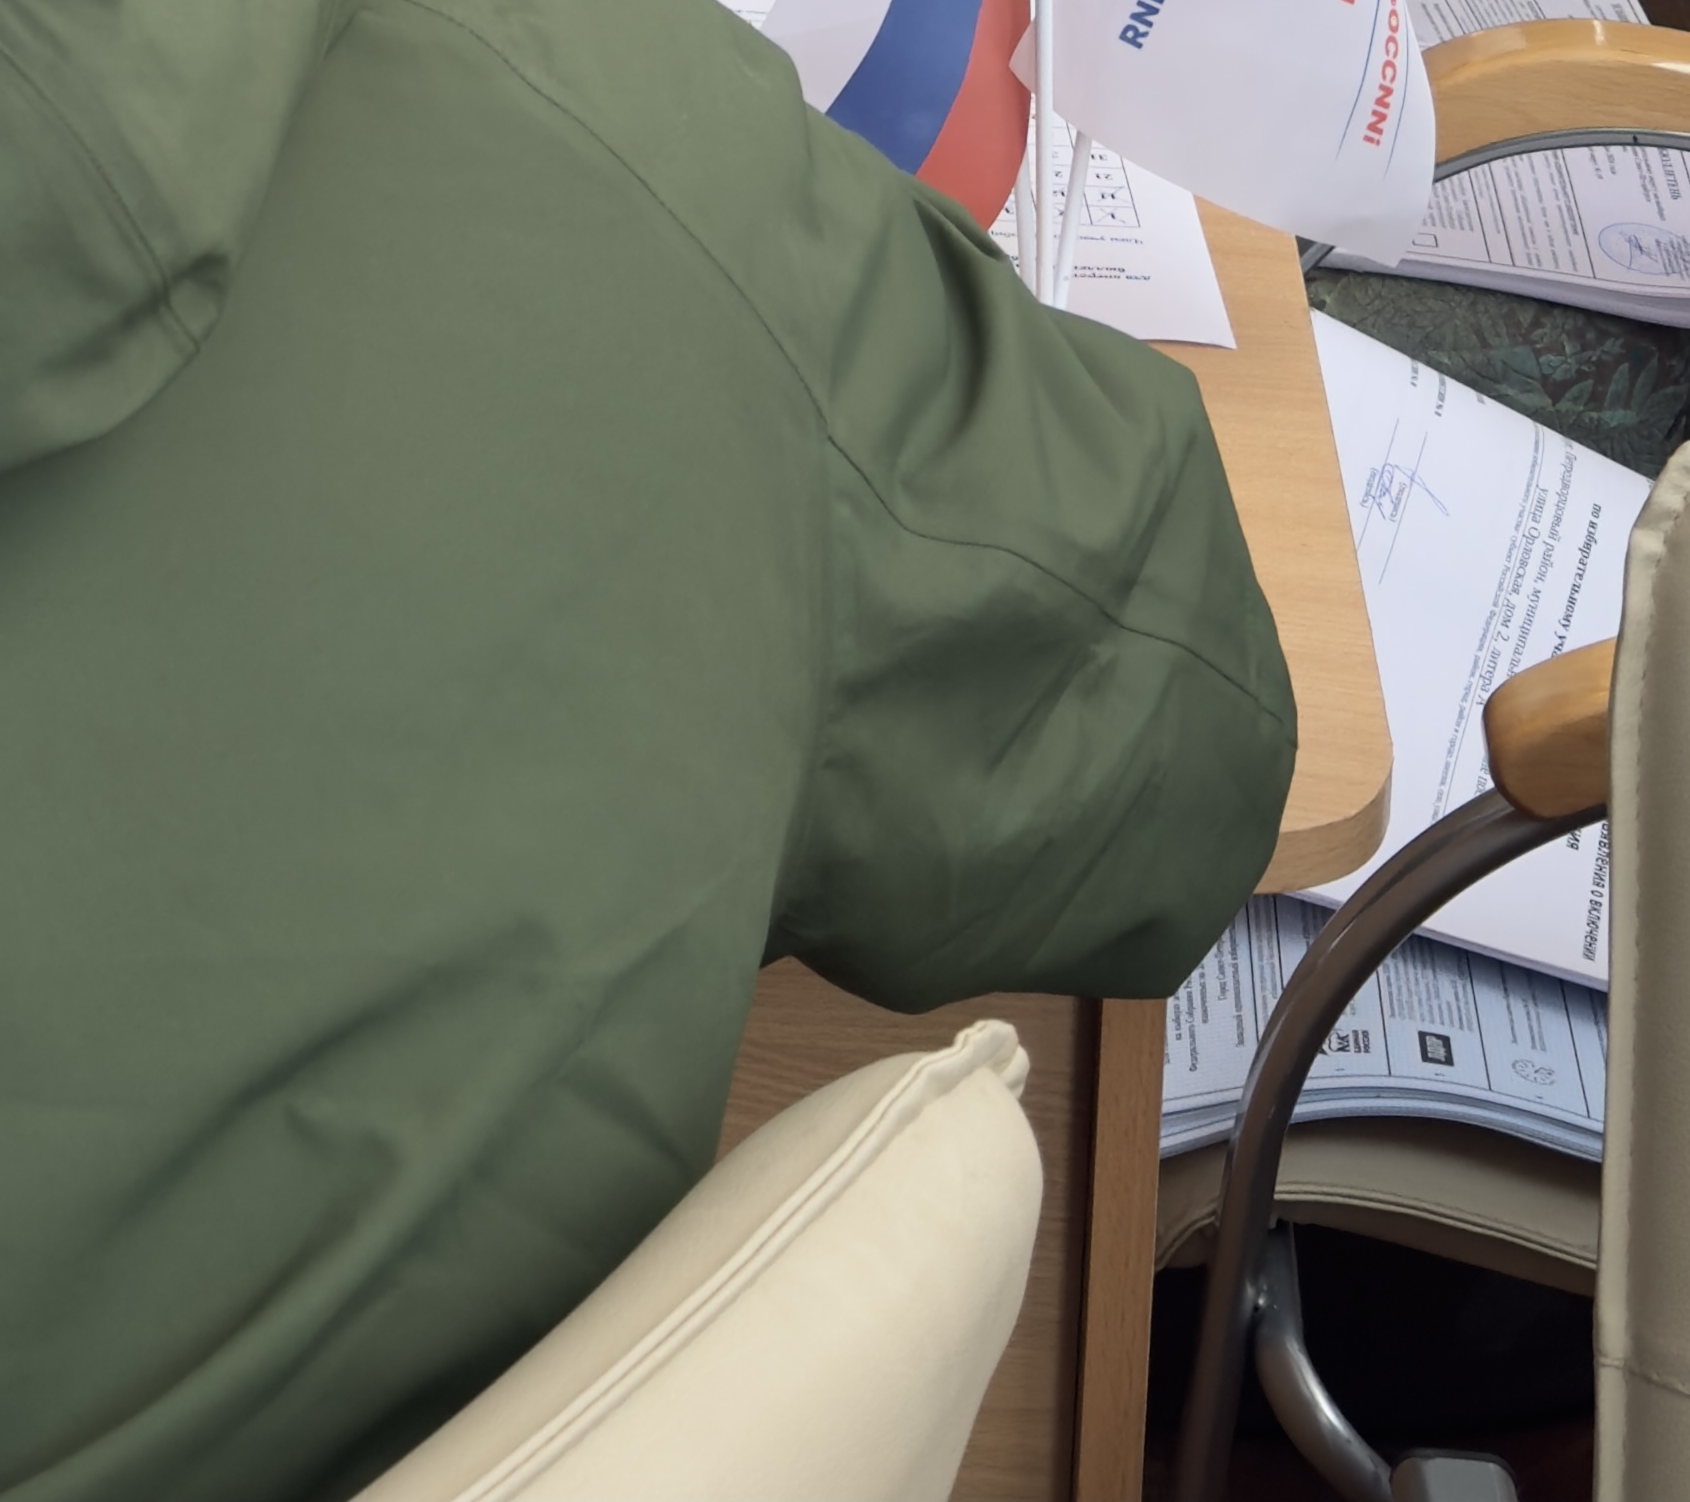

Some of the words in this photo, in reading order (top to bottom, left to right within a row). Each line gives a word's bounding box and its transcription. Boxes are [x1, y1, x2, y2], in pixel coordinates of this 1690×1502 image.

[1526, 484, 1552, 526] улица
[1588, 501, 1603, 519] по
[1504, 524, 1543, 598] Орловская,
[1529, 539, 1558, 586] район,
[1554, 518, 1604, 632] избирательному
[1491, 628, 1509, 645] 2,
[1495, 599, 1516, 630] дом
[1476, 644, 1504, 692] литера
[1589, 889, 1604, 897] о
[1579, 897, 1603, 962] включении
